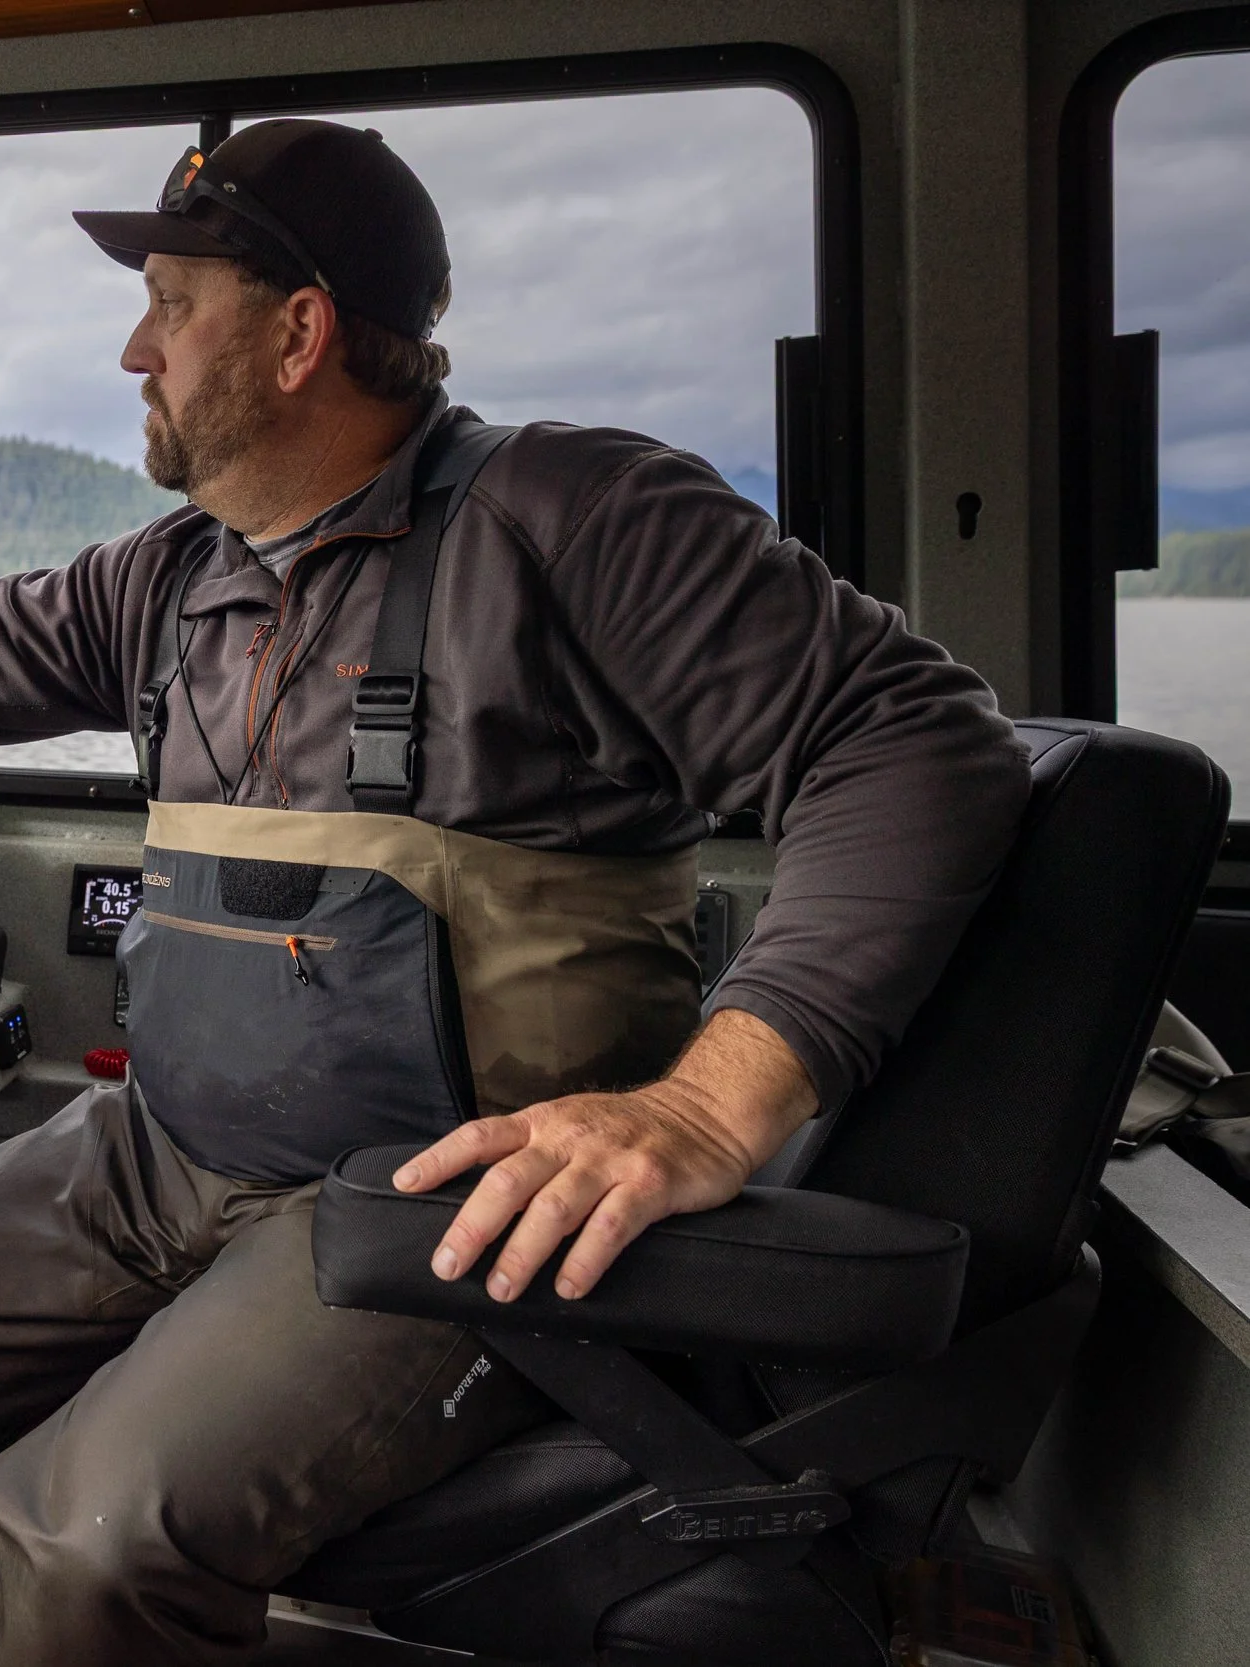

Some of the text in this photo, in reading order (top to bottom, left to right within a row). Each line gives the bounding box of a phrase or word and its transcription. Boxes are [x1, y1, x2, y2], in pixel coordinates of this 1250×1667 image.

[103, 882, 131, 897] 40.5
[102, 900, 130, 915] 0.15
[480, 1363, 492, 1377] PRO
